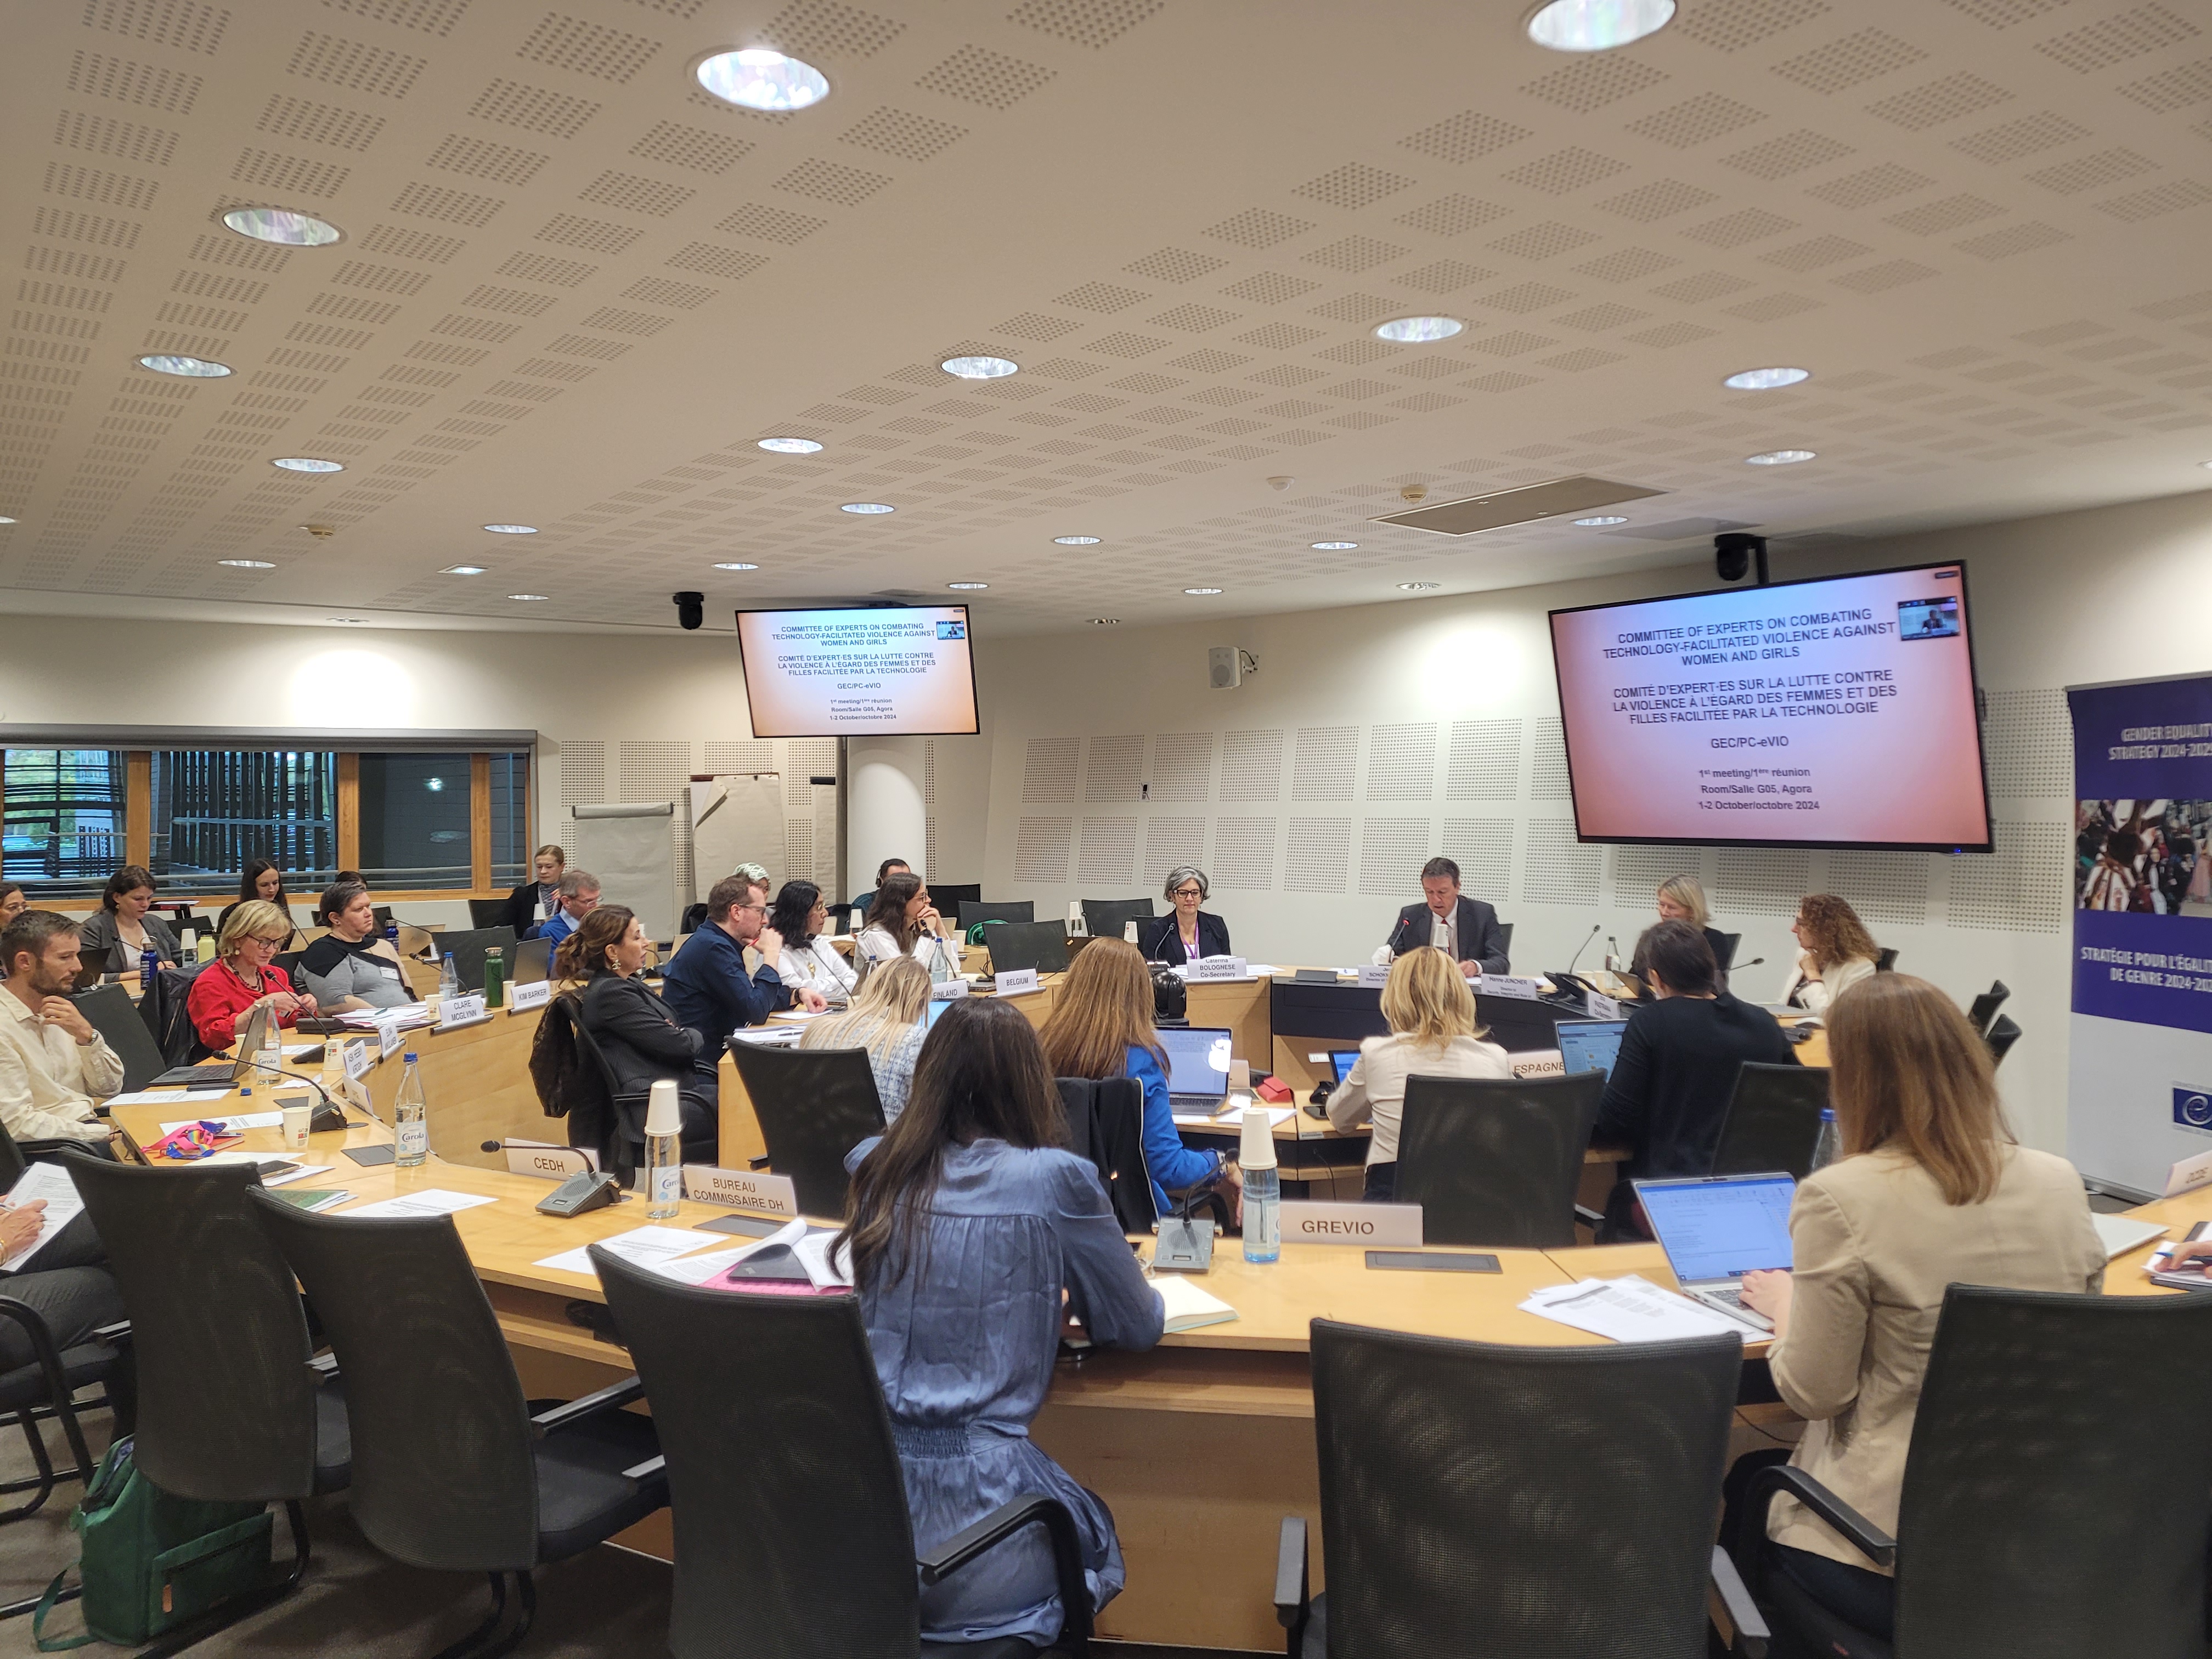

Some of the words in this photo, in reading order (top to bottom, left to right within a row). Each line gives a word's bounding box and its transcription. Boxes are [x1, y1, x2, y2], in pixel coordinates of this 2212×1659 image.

[1617, 627, 1685, 644] COMMITTEE
[1687, 625, 1703, 637] OF
[1706, 619, 1764, 635] EXPERTS
[1767, 616, 1787, 630] ON
[1789, 607, 1873, 628] COMBATING
[771, 631, 866, 640] TECHNOLOGY-FACILITATED
[1603, 634, 1760, 659] TECHNOLOGY-FACILITATED
[1763, 628, 1830, 645] VIOLENCE
[1832, 621, 1897, 639] AGAINST
[1681, 652, 1728, 667] WOMEN
[1730, 649, 1758, 663] AND
[1760, 645, 1801, 661] GIRLS
[1612, 683, 1656, 699] COMITÉ
[1738, 678, 1765, 691] SUR
[1768, 676, 1786, 689] LA
[1788, 673, 1831, 688] LUTTE
[1833, 669, 1894, 685] CONTRE
[1613, 701, 1628, 712] LA
[1629, 697, 1686, 712] VIOLENCE
[1688, 694, 1699, 708] À
[1757, 691, 1784, 704] DES
[1786, 688, 1844, 703] FEMMES
[1847, 686, 1865, 699] ET
[1868, 685, 1898, 698] DES
[1629, 713, 1668, 725] FILLES
[1669, 707, 1730, 723] FACILITÉE
[1733, 708, 1759, 720] PAR
[1761, 707, 1779, 719] LA
[1781, 701, 1880, 718] TECHNOLOGIE
[2121, 726, 2164, 742] GENDER
[2164, 723, 2212, 740] EQUALIT
[1710, 736, 1789, 748] GEC/PC-eVIO
[2108, 745, 2160, 760] STRATEGY
[1771, 766, 1810, 777] réunion
[1700, 784, 1755, 794] Room/Salle
[1780, 784, 1813, 796] Agora
[1698, 800, 1712, 810] 1-2
[1713, 800, 1793, 810] October/octobre
[1795, 800, 1820, 810] 2024
[2081, 946, 2133, 965] STRATÉGIE
[2134, 952, 2167, 968] POUR
[1006, 977, 1029, 986] BELGIUM
[2110, 967, 2125, 981] DE
[2125, 969, 2164, 986] GENRE
[518, 993, 527, 1001] KIM
[528, 989, 546, 998] BARKER
[933, 989, 957, 998] FINLAND
[454, 1000, 472, 1010] CLARE
[452, 1009, 477, 1022] MCGLYNN
[1514, 1062, 1564, 1074] ESPAGNE
[402, 1132, 424, 1142] Carola
[534, 1158, 565, 1173] CEDH
[662, 1179, 679, 1189] Caro
[712, 1178, 755, 1193] BUREAU
[693, 1189, 766, 1208] COMMISSAIRE
[769, 1198, 784, 1211] DH
[1302, 1220, 1374, 1235] GREVIO
